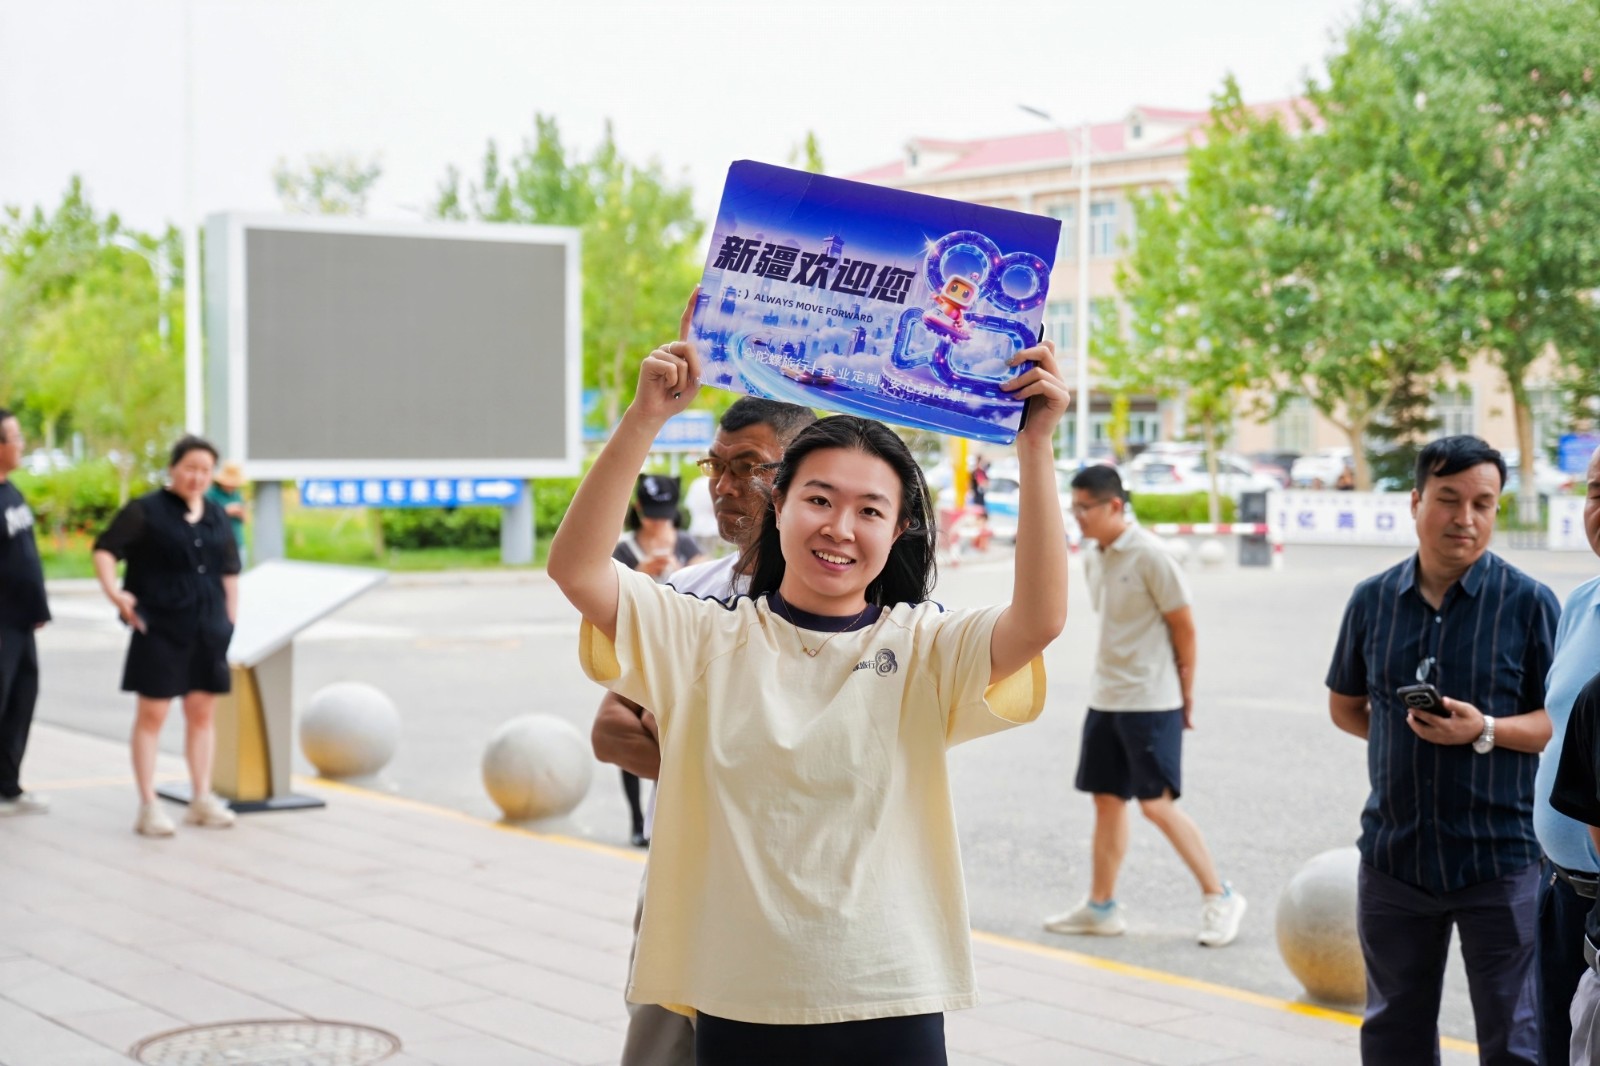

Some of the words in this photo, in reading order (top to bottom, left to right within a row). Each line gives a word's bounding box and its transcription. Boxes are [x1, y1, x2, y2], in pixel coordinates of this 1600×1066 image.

[712, 235, 917, 305] 新疆欢迎您
[754, 293, 794, 309] ALWAYS
[795, 302, 824, 314] MOVE
[826, 307, 874, 324] FORWARD
